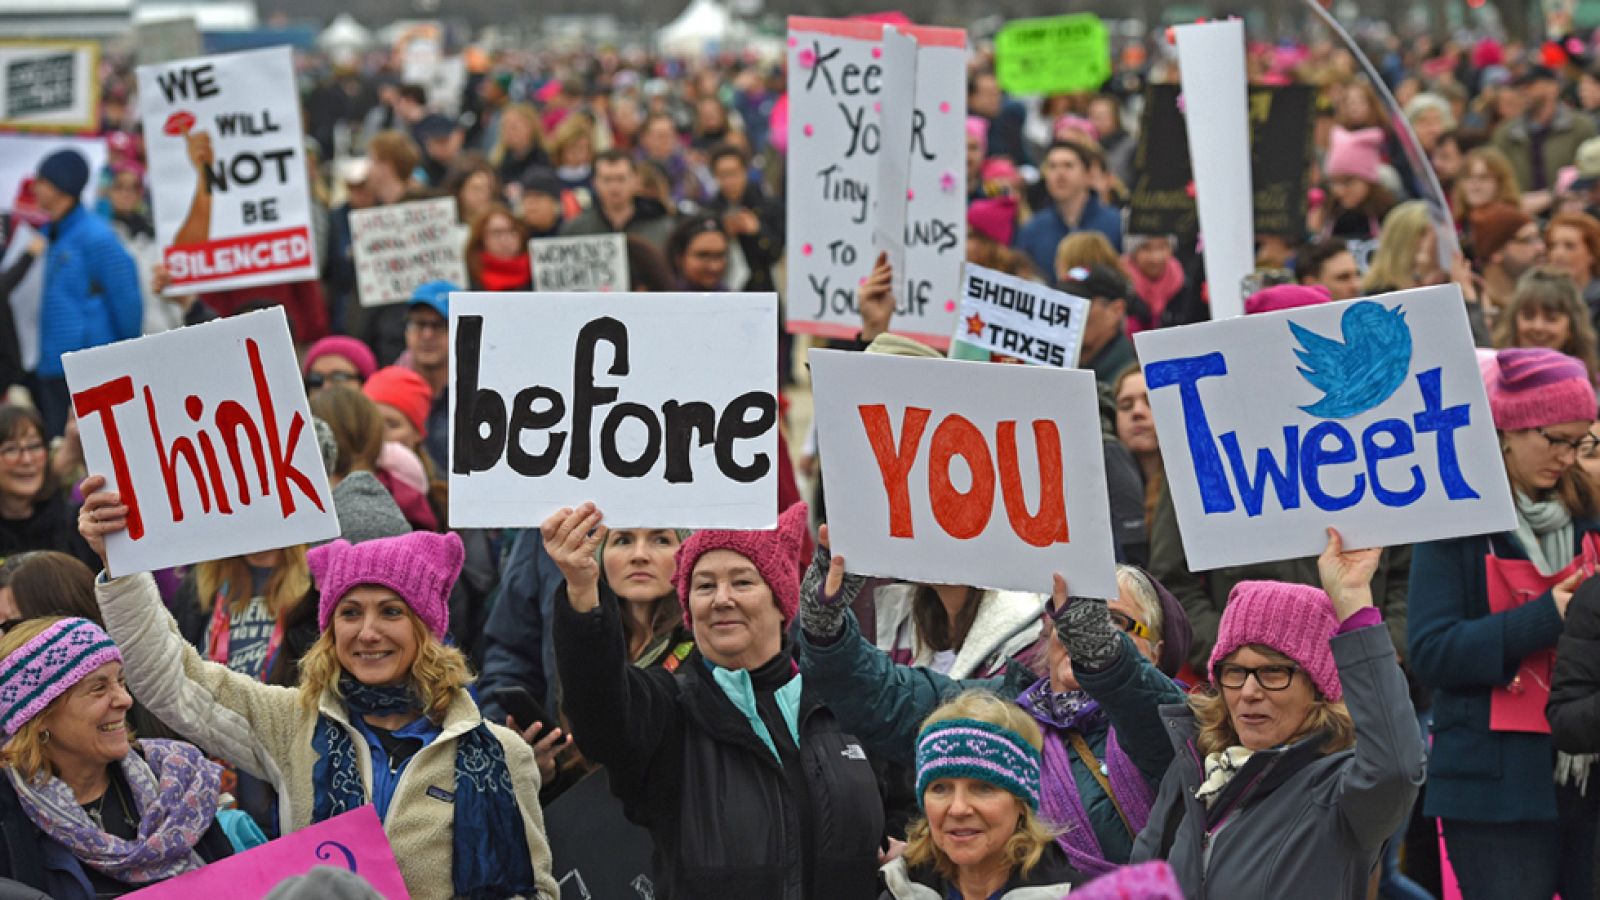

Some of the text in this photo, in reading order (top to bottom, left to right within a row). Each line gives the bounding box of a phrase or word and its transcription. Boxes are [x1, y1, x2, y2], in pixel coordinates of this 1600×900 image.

[156, 64, 220, 103] WE
[806, 40, 882, 95] Kee
[214, 107, 281, 137] WILL
[203, 148, 294, 194] NOT
[241, 197, 279, 225] BE
[167, 236, 309, 277] SILENCED
[452, 315, 777, 483] before
[72, 337, 326, 541] Think
[1144, 351, 1481, 518] Tweet
[857, 403, 1071, 548] YOU
